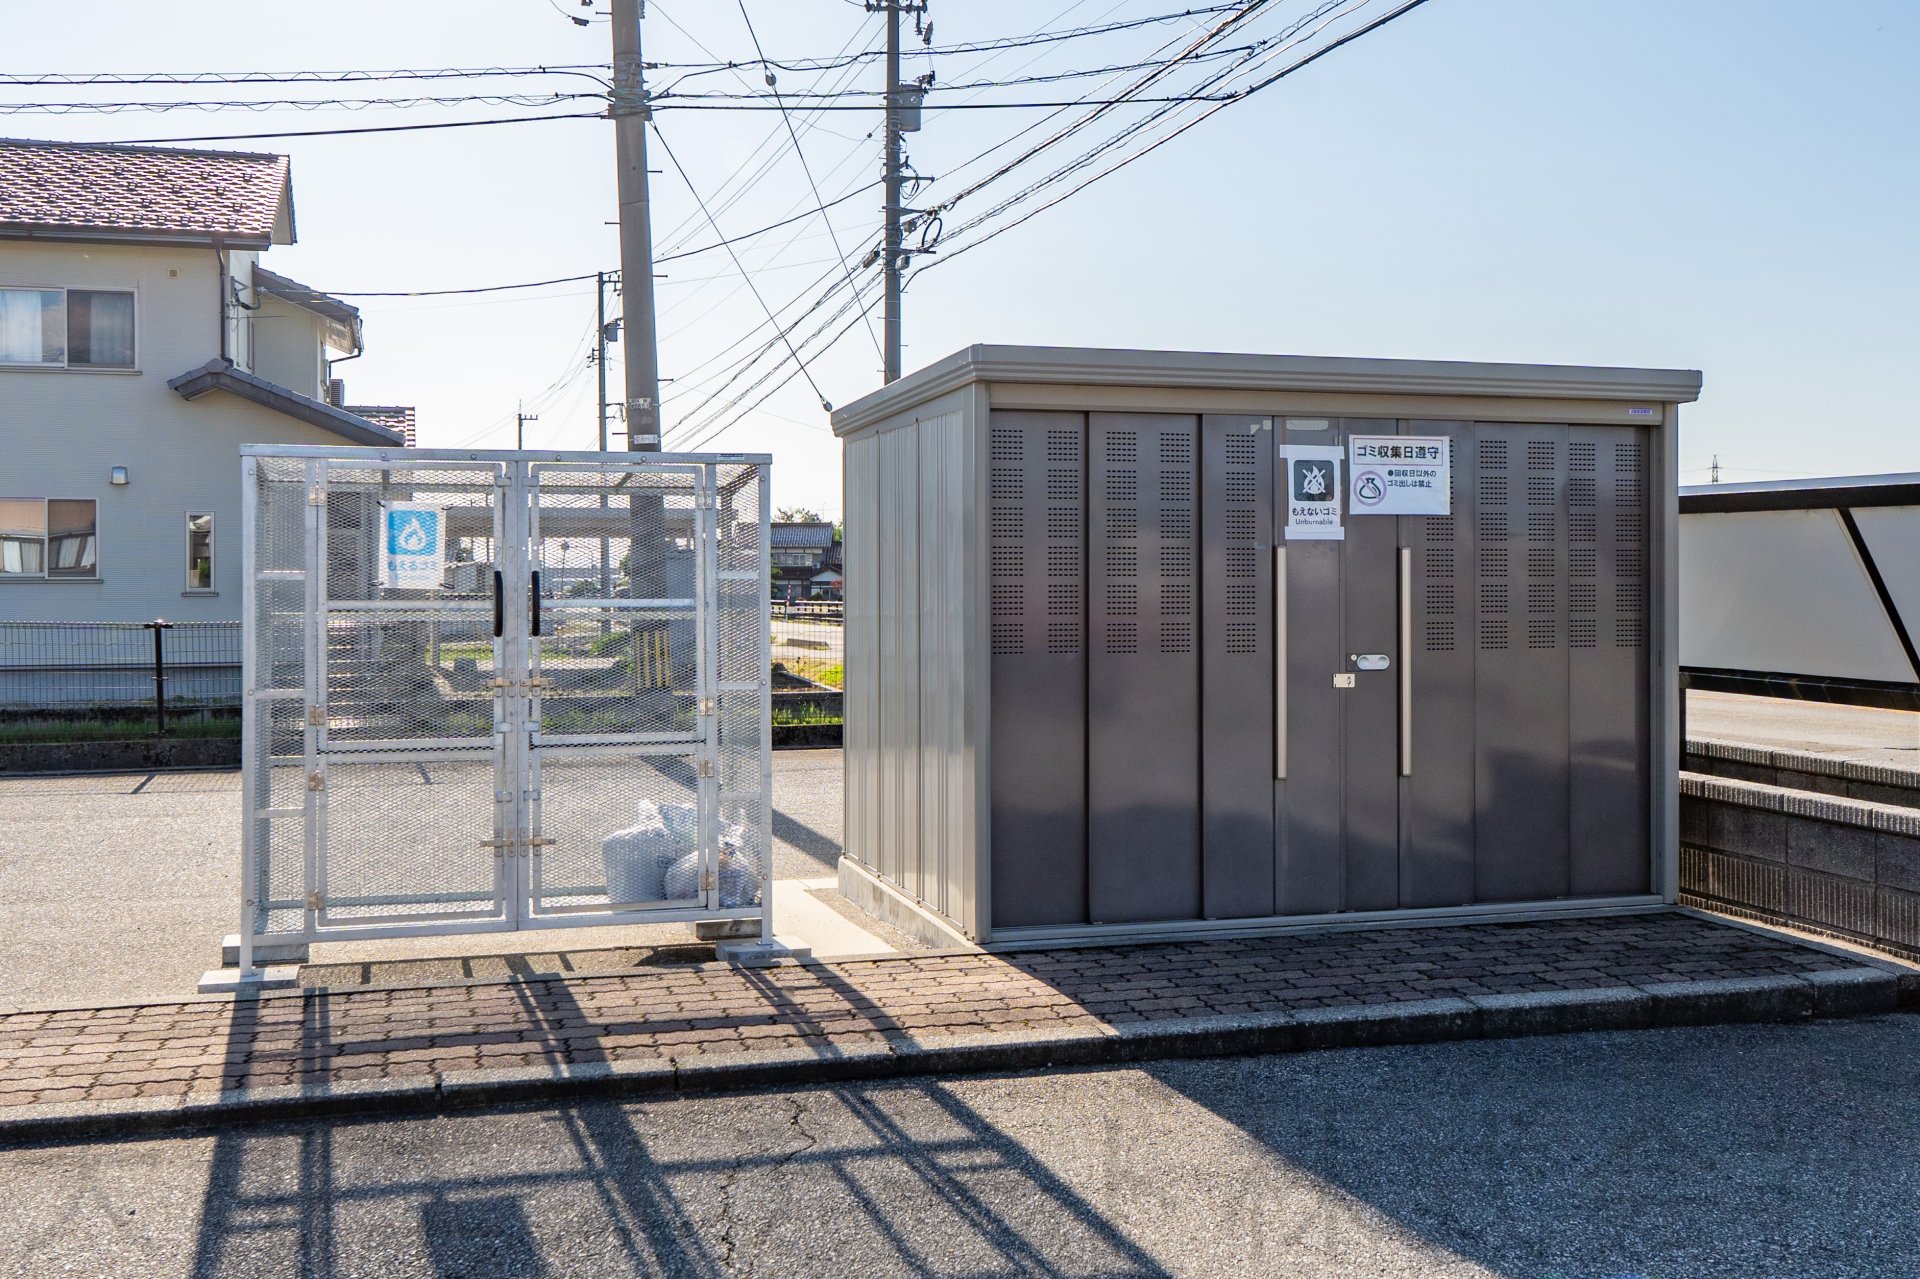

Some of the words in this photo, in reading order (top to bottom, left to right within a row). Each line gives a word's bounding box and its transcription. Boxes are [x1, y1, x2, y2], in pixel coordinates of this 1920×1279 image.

[1356, 444, 1440, 459] ゴミ収集日遵守
[1387, 479, 1432, 488] ゴミ出しは禁止
[1291, 506, 1338, 516] もえないゴミ
